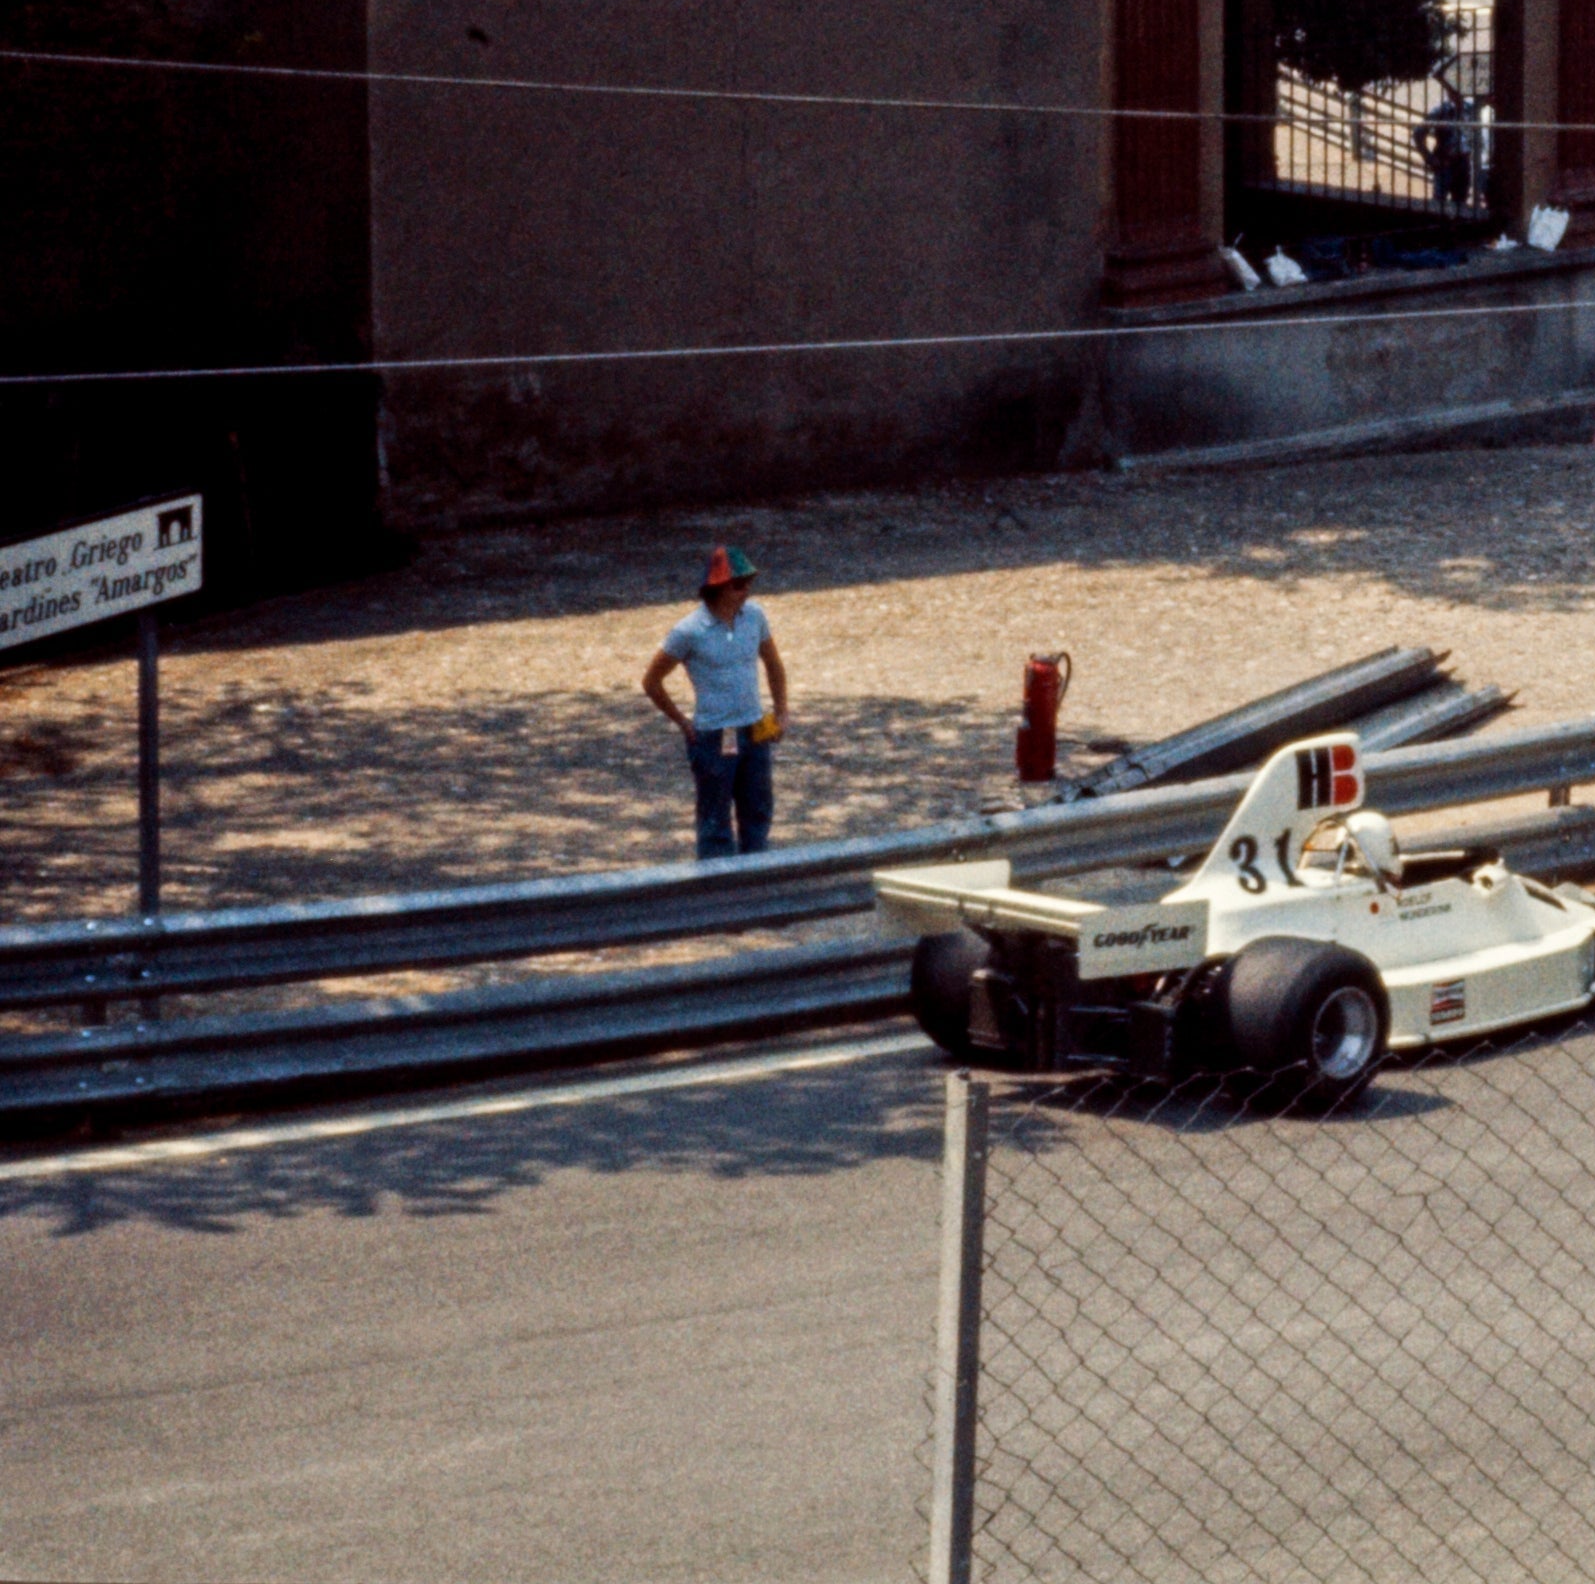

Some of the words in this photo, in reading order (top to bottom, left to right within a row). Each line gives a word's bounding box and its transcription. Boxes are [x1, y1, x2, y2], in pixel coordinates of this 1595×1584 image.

[70, 531, 143, 567] Griego
[1295, 744, 1359, 811] HB
[1229, 827, 1305, 895] 31
